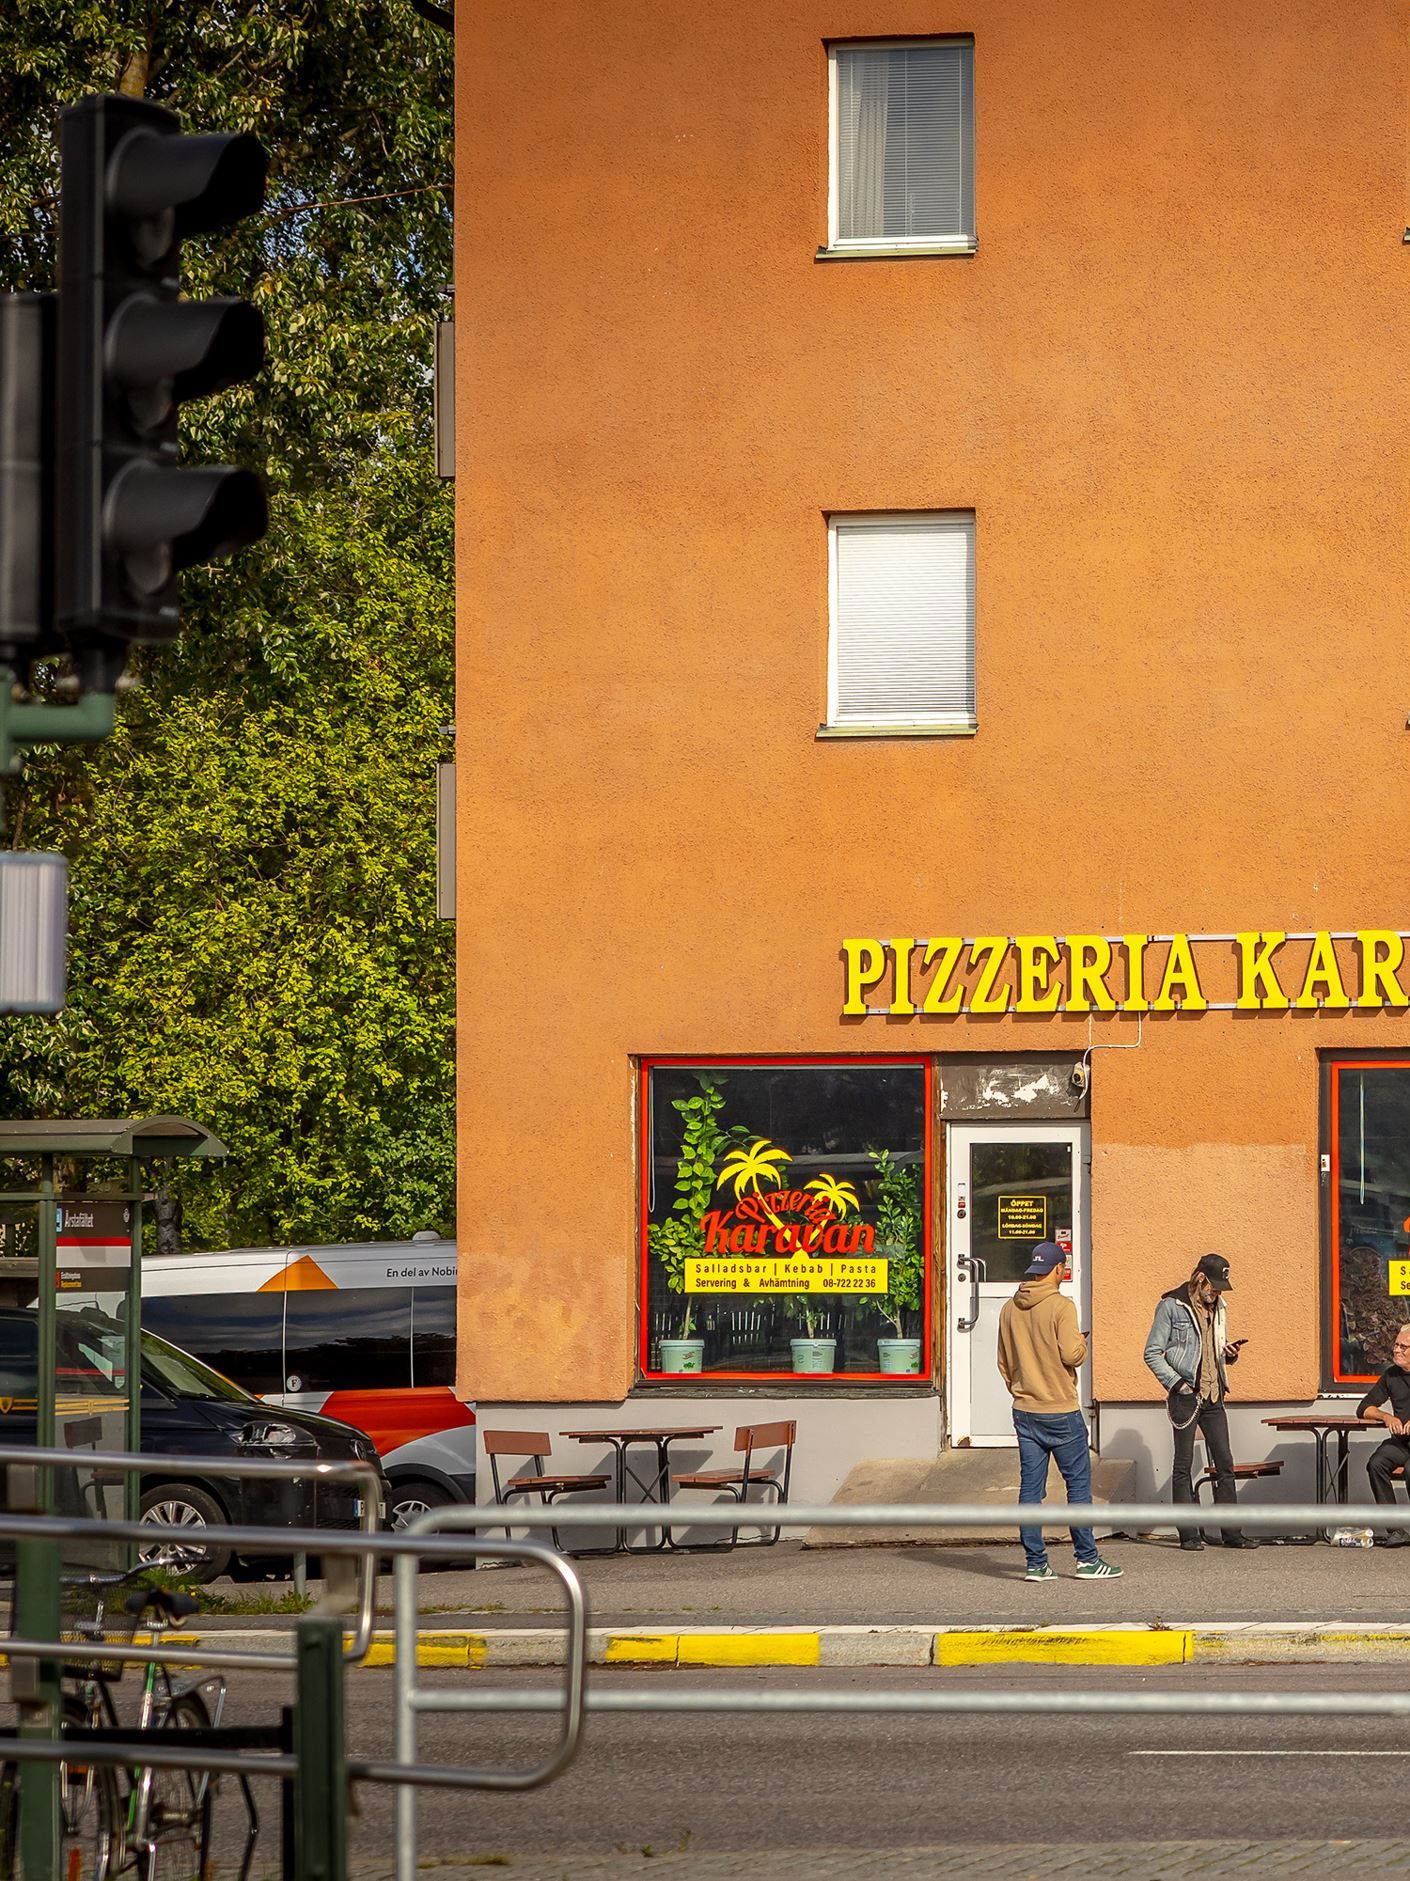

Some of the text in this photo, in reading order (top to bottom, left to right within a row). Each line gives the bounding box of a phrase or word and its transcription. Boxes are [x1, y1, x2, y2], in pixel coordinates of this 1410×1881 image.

[843, 934, 1207, 1015] PIZZERIA
[735, 1190, 837, 1225] Pizzeria
[1010, 1199, 1034, 1207] ÖPPET
[700, 1210, 877, 1254] Karavan
[386, 1268, 399, 1278] En
[400, 1267, 416, 1277] del
[695, 1263, 767, 1274] Salladsbar
[784, 1263, 823, 1274] Kebab
[840, 1263, 877, 1274] Pasta
[695, 1278, 876, 1290] Servering & Avhämtning 08-722 22 36
